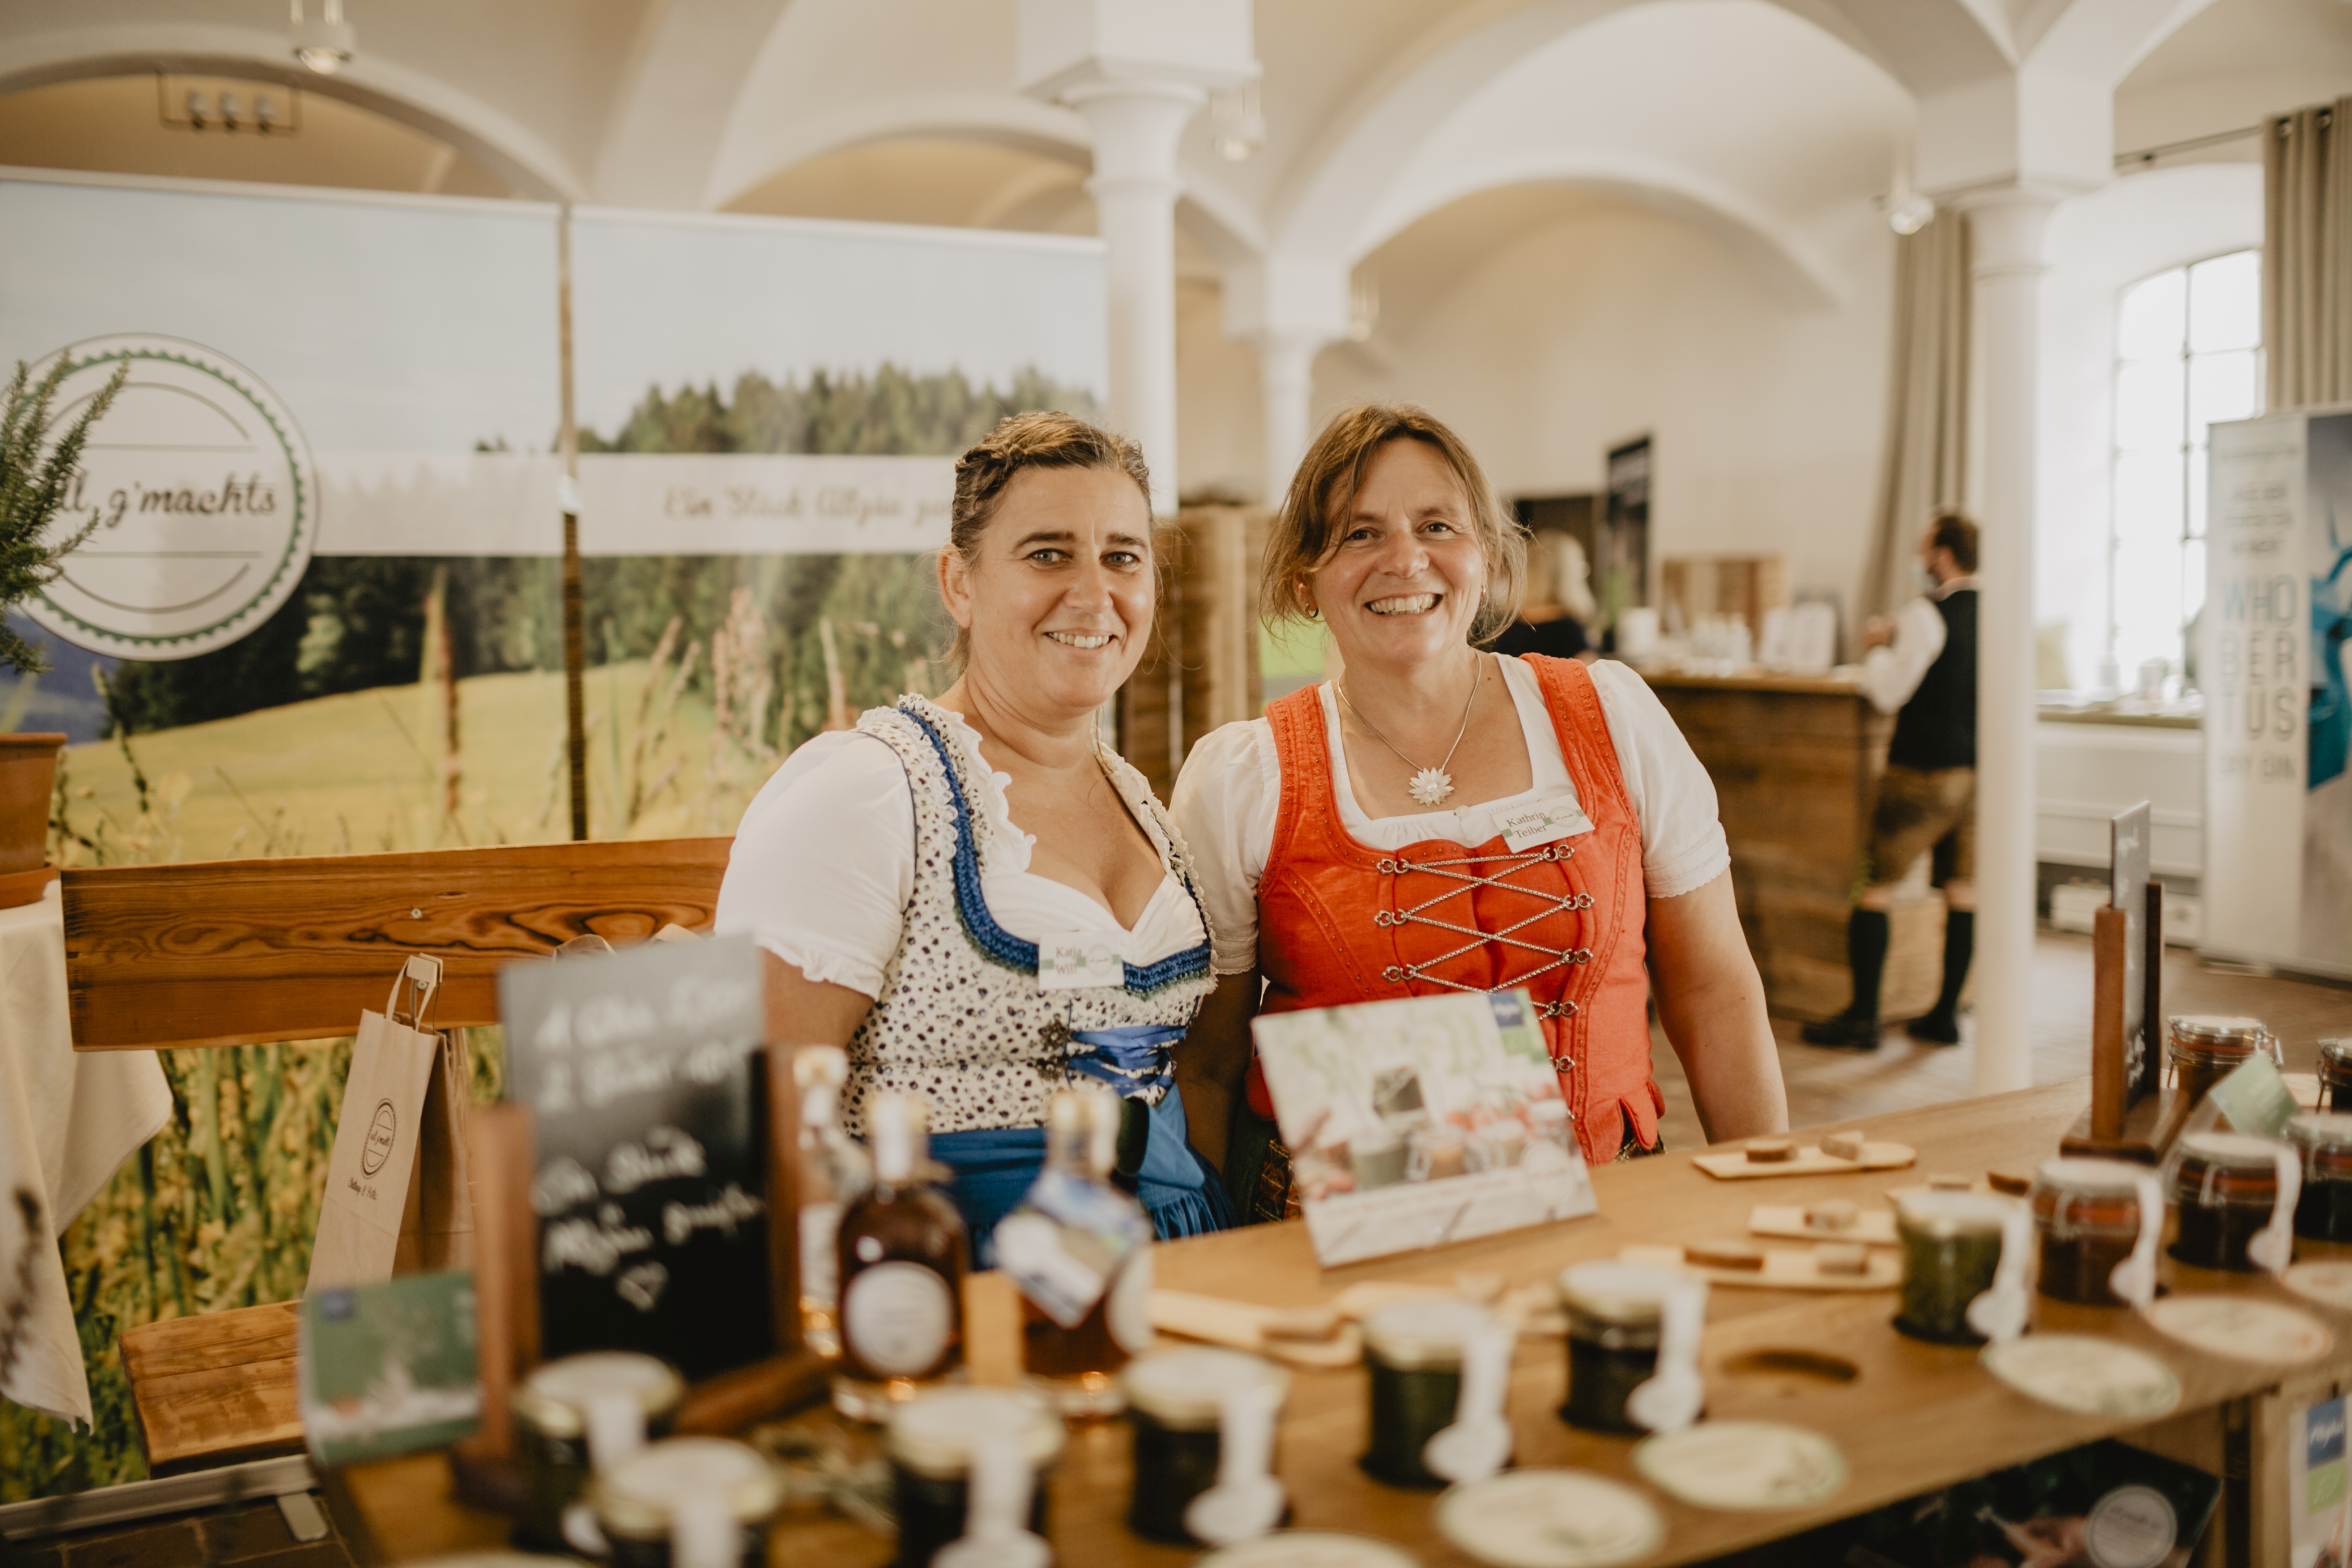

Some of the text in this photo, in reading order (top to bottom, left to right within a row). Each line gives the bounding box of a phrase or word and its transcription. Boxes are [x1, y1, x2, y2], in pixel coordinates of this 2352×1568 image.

[105, 472, 276, 529] g'machts
[2221, 574, 2297, 628] WHO
[2219, 630, 2297, 683] BER
[1506, 811, 1547, 827] Kathrin
[1513, 824, 1547, 839] Teiber
[1055, 946, 1082, 959] Katja
[1055, 963, 1077, 975] Will
